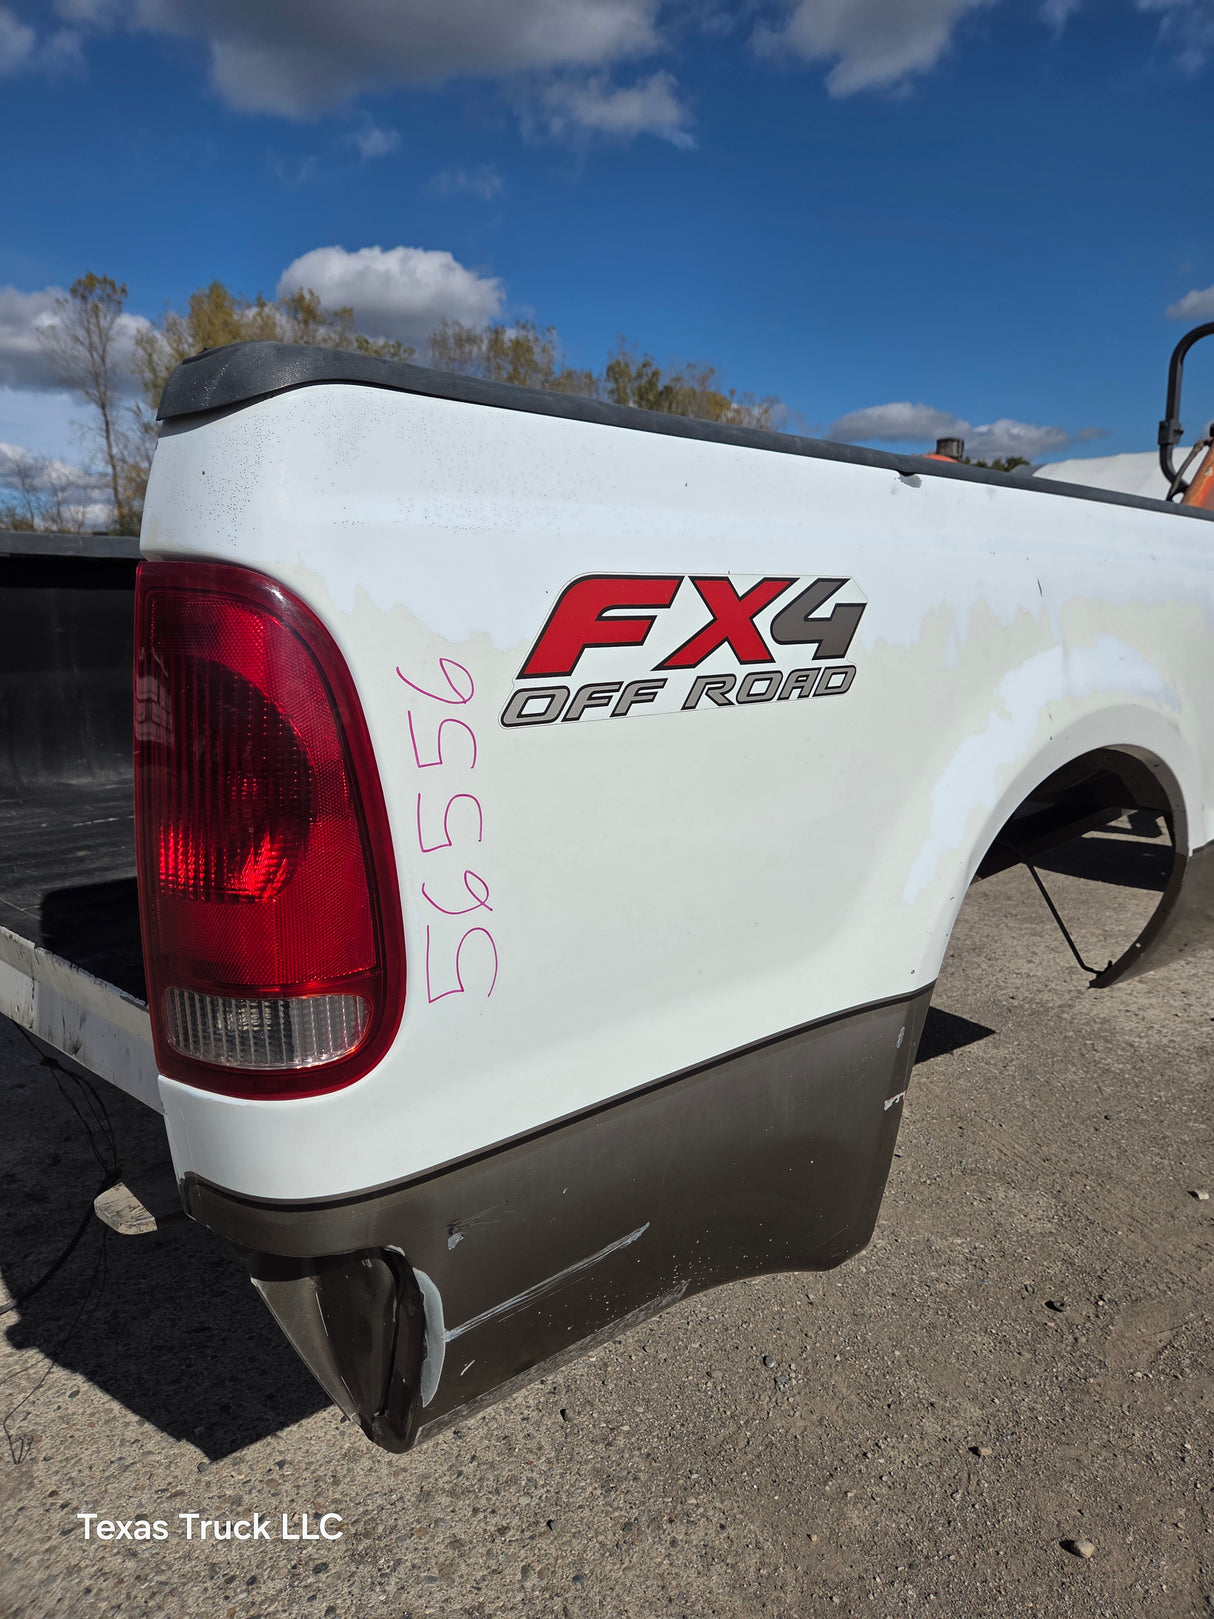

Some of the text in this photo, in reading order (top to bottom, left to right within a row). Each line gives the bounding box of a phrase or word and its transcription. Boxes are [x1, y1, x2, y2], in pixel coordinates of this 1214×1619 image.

[516, 574, 868, 679] FX4
[500, 664, 857, 728] OFF ROAD
[395, 657, 498, 1004] 56556
